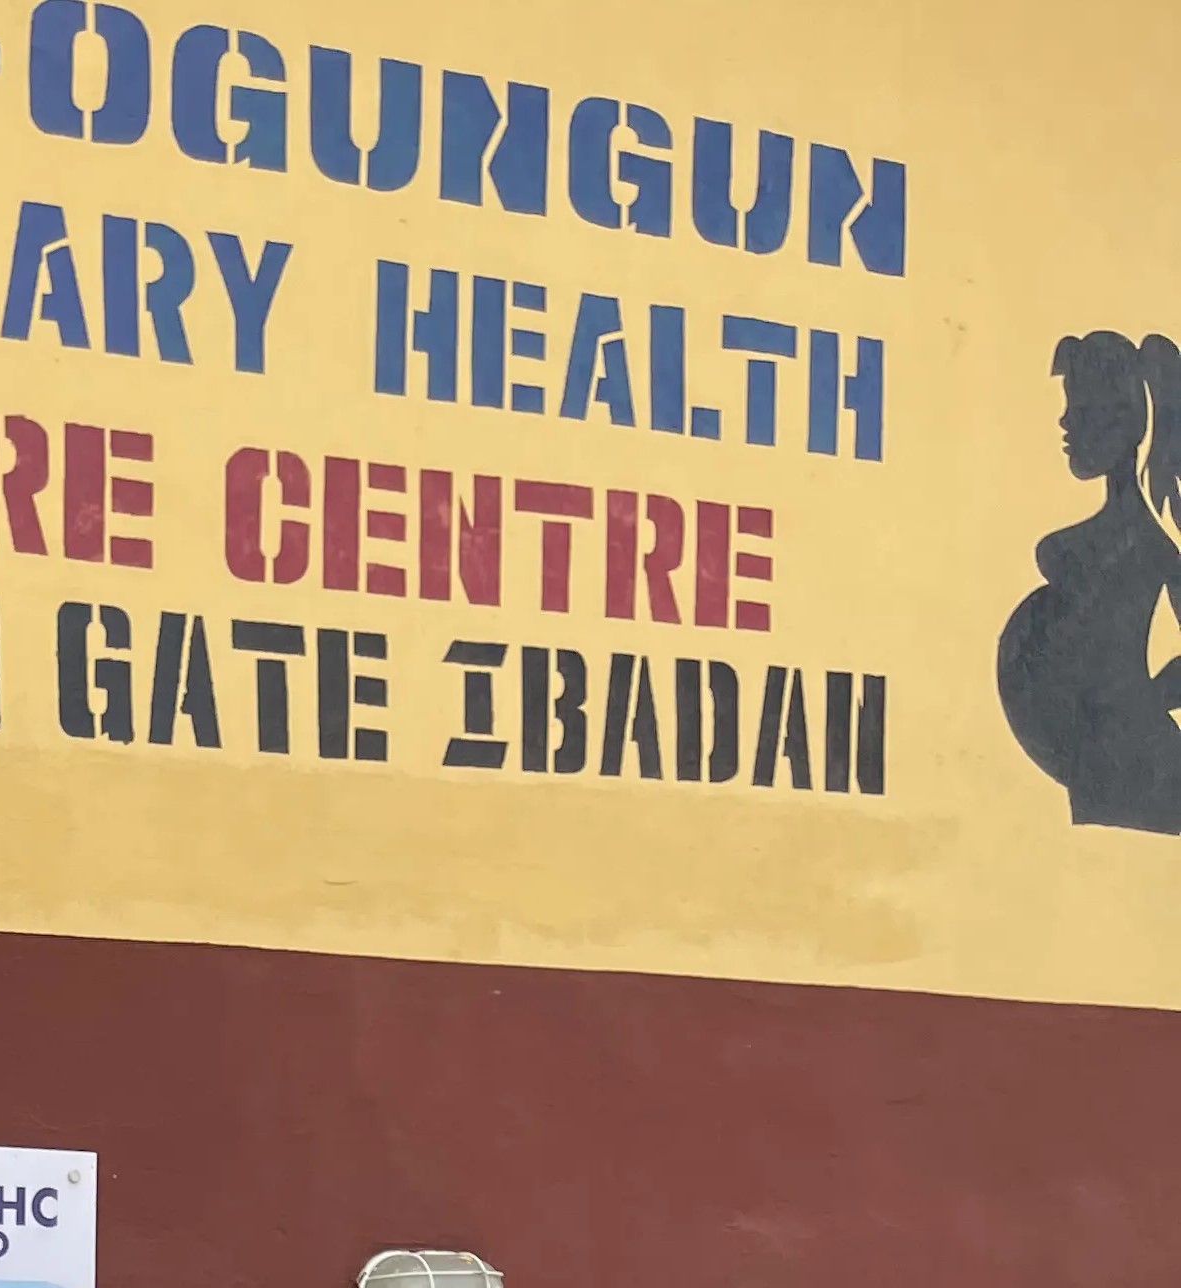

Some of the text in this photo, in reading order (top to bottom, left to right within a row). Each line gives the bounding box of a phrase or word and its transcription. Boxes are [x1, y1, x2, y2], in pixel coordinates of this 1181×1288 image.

[373, 257, 885, 462] HEALTH
[221, 446, 776, 632] CENTRE
[55, 600, 389, 763] GATE
[441, 638, 888, 796] IBADAN
